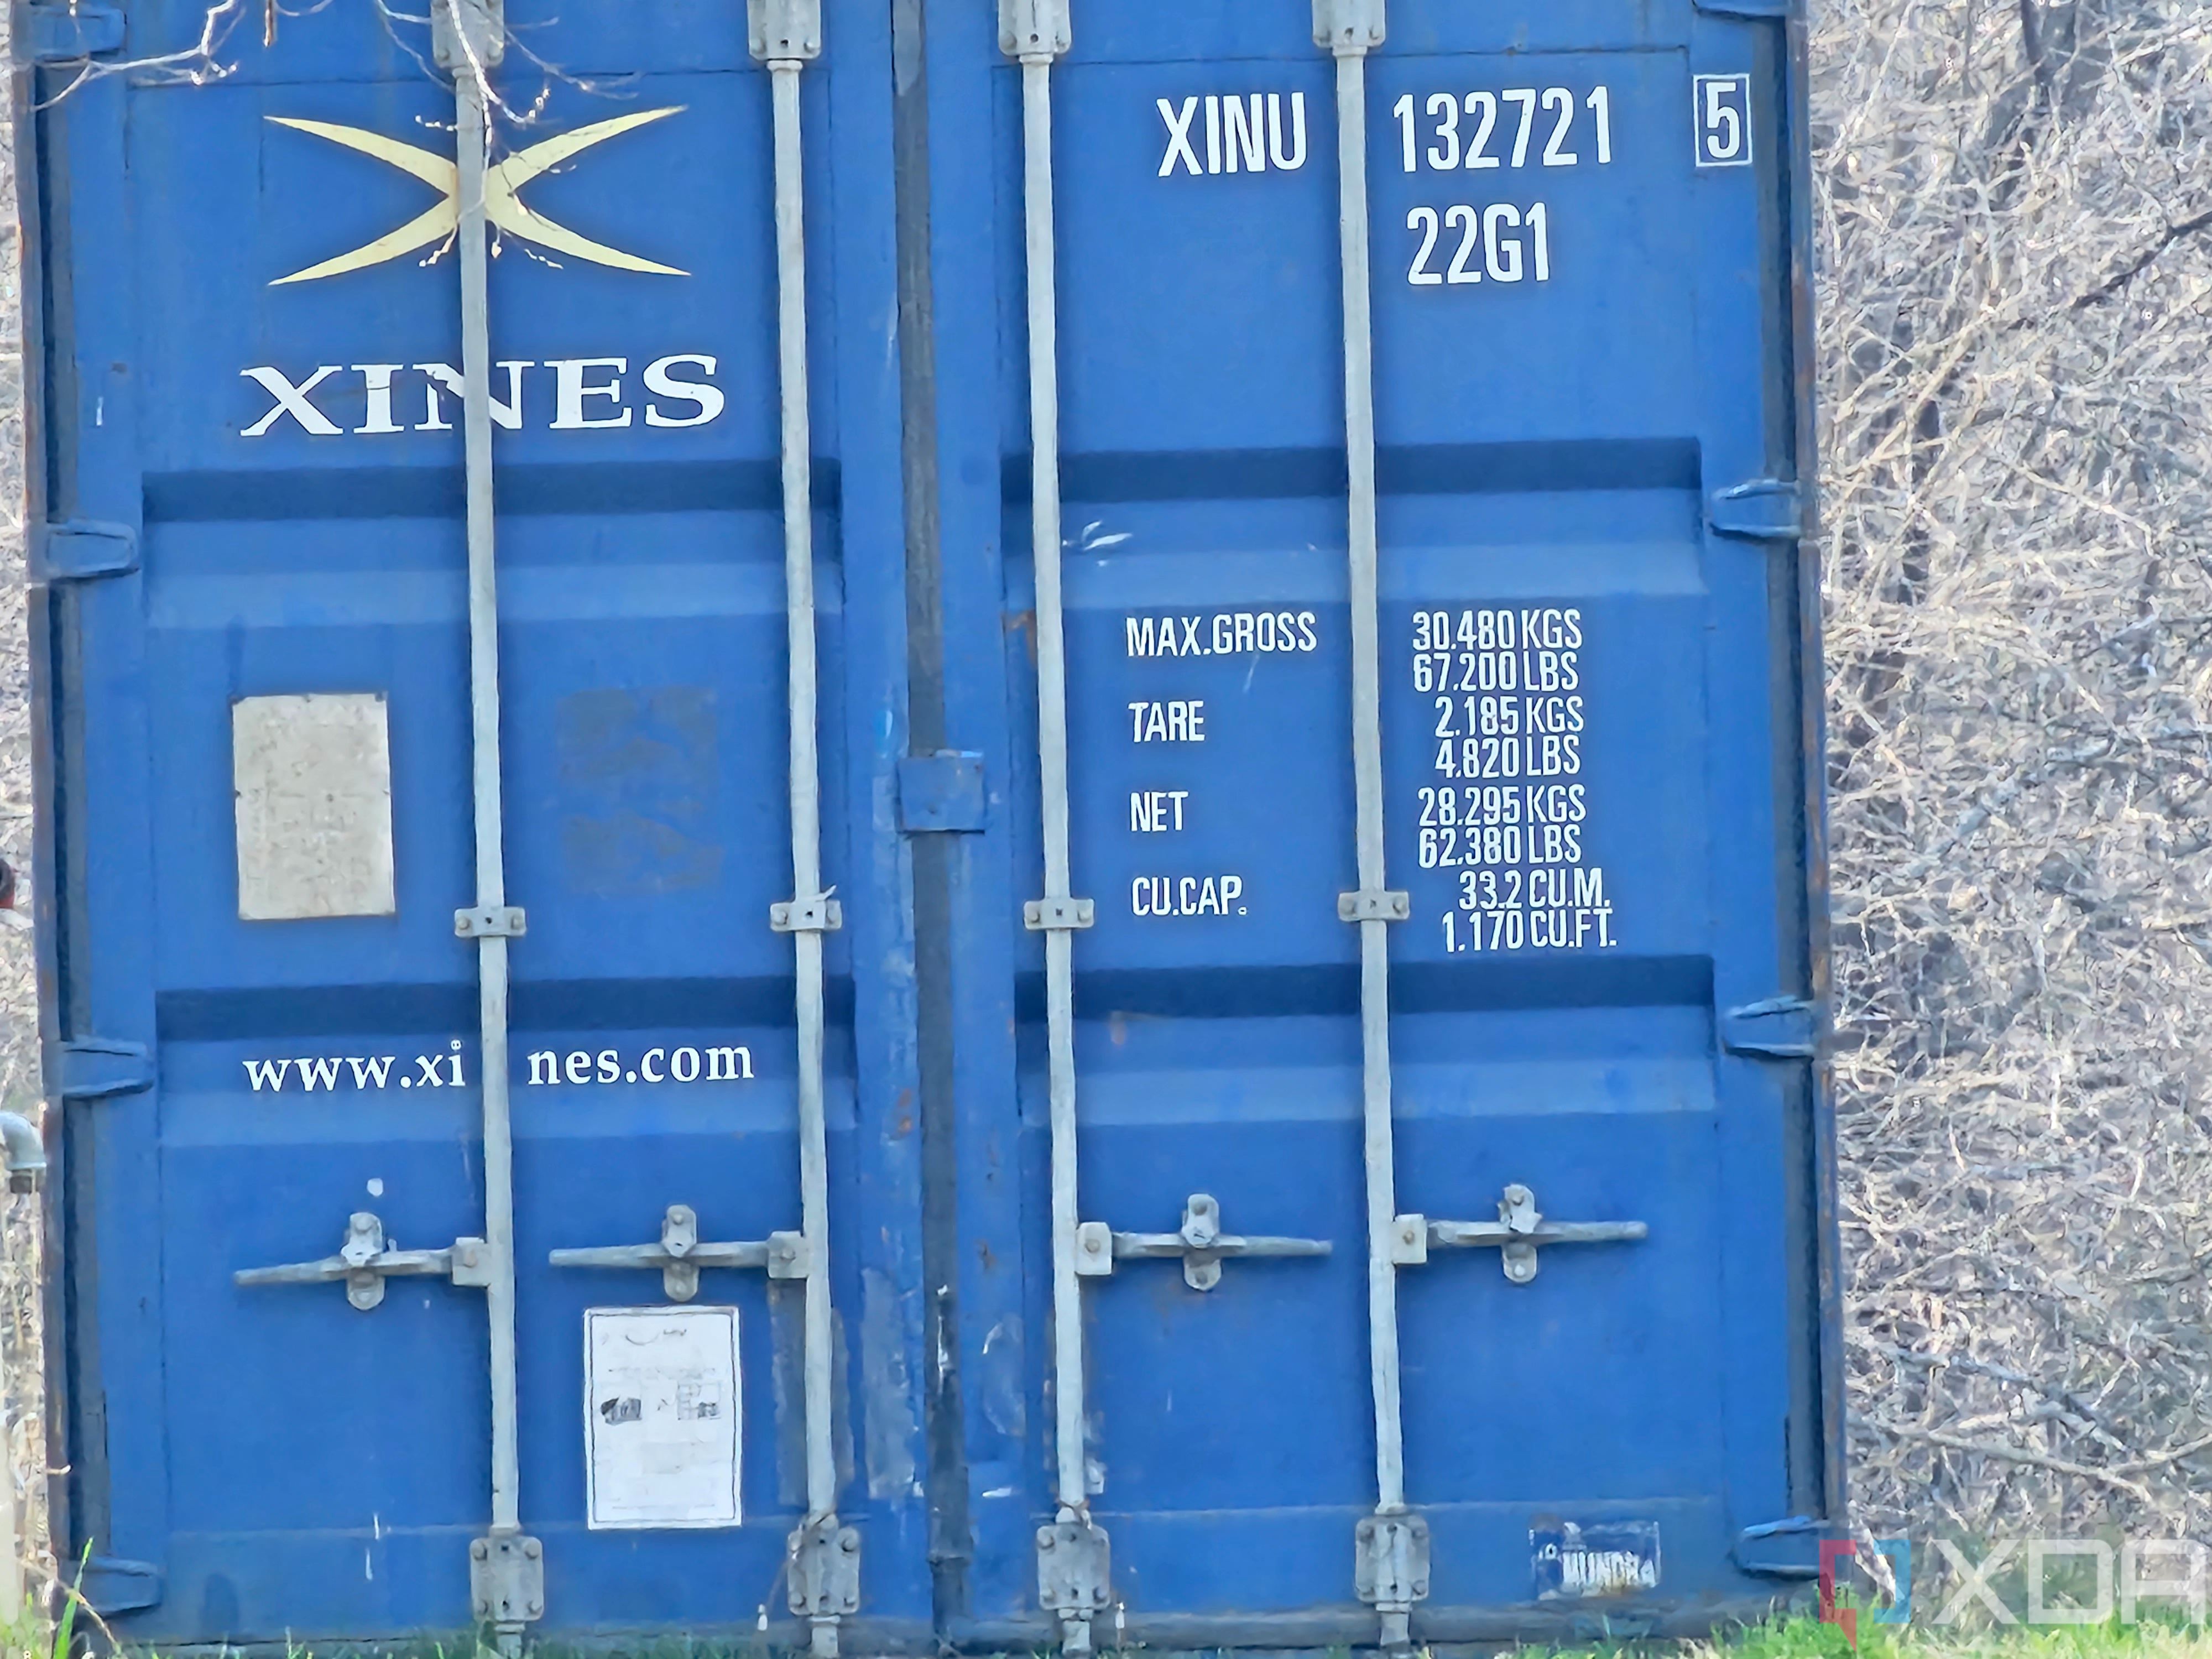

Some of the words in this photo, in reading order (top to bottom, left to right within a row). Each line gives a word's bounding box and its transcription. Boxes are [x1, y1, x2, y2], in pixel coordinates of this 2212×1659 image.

[1156, 92, 1306, 177] XINU
[1394, 86, 1611, 172] 132721
[1706, 82, 1740, 158] 5
[1406, 202, 1550, 285] 22G1
[239, 354, 724, 436] XINES
[1126, 612, 1317, 656] MAX.GROSS
[1413, 610, 1515, 650] 30.480
[1521, 609, 1582, 649] KGS
[1413, 651, 1517, 692] 67.200
[1524, 651, 1578, 691] LBS
[1128, 701, 1206, 743] TARE
[1434, 696, 1519, 738] 2.185
[1526, 696, 1584, 734] KGS
[1434, 737, 1520, 779] 4.820
[1526, 734, 1580, 775] LBS
[1130, 791, 1188, 832] NET
[1418, 786, 1520, 826] 28.295
[1526, 784, 1587, 823] KGS
[1418, 826, 1521, 868] 62.380
[1527, 824, 1582, 864] LBS
[1132, 875, 1248, 916] CU.CAP.
[1459, 870, 1522, 910] 33.2
[1529, 867, 1611, 908] CU.M.
[1442, 910, 1525, 952] 1.170
[1530, 908, 1618, 948] CU.FT.
[242, 1040, 466, 1092] www.xi
[527, 1045, 754, 1085] nes.com
